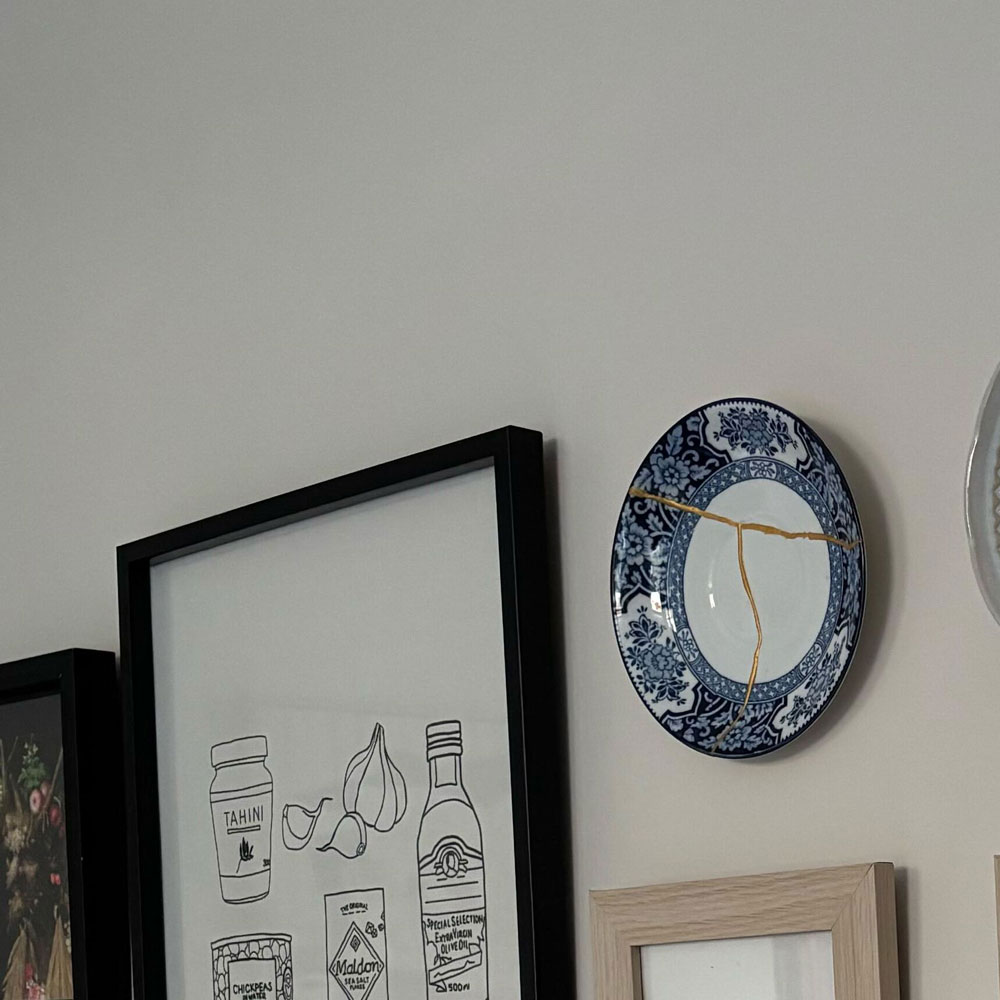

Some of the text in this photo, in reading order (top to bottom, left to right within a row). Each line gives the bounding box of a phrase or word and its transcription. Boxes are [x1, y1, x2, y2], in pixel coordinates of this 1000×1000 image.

[224, 805, 263, 827] TAHINI
[441, 939, 469, 954] OLIVE OIL
[336, 957, 380, 976] Maldon
[345, 976, 369, 985] SEA SALT
[233, 982, 272, 995] CHICKPEAS
